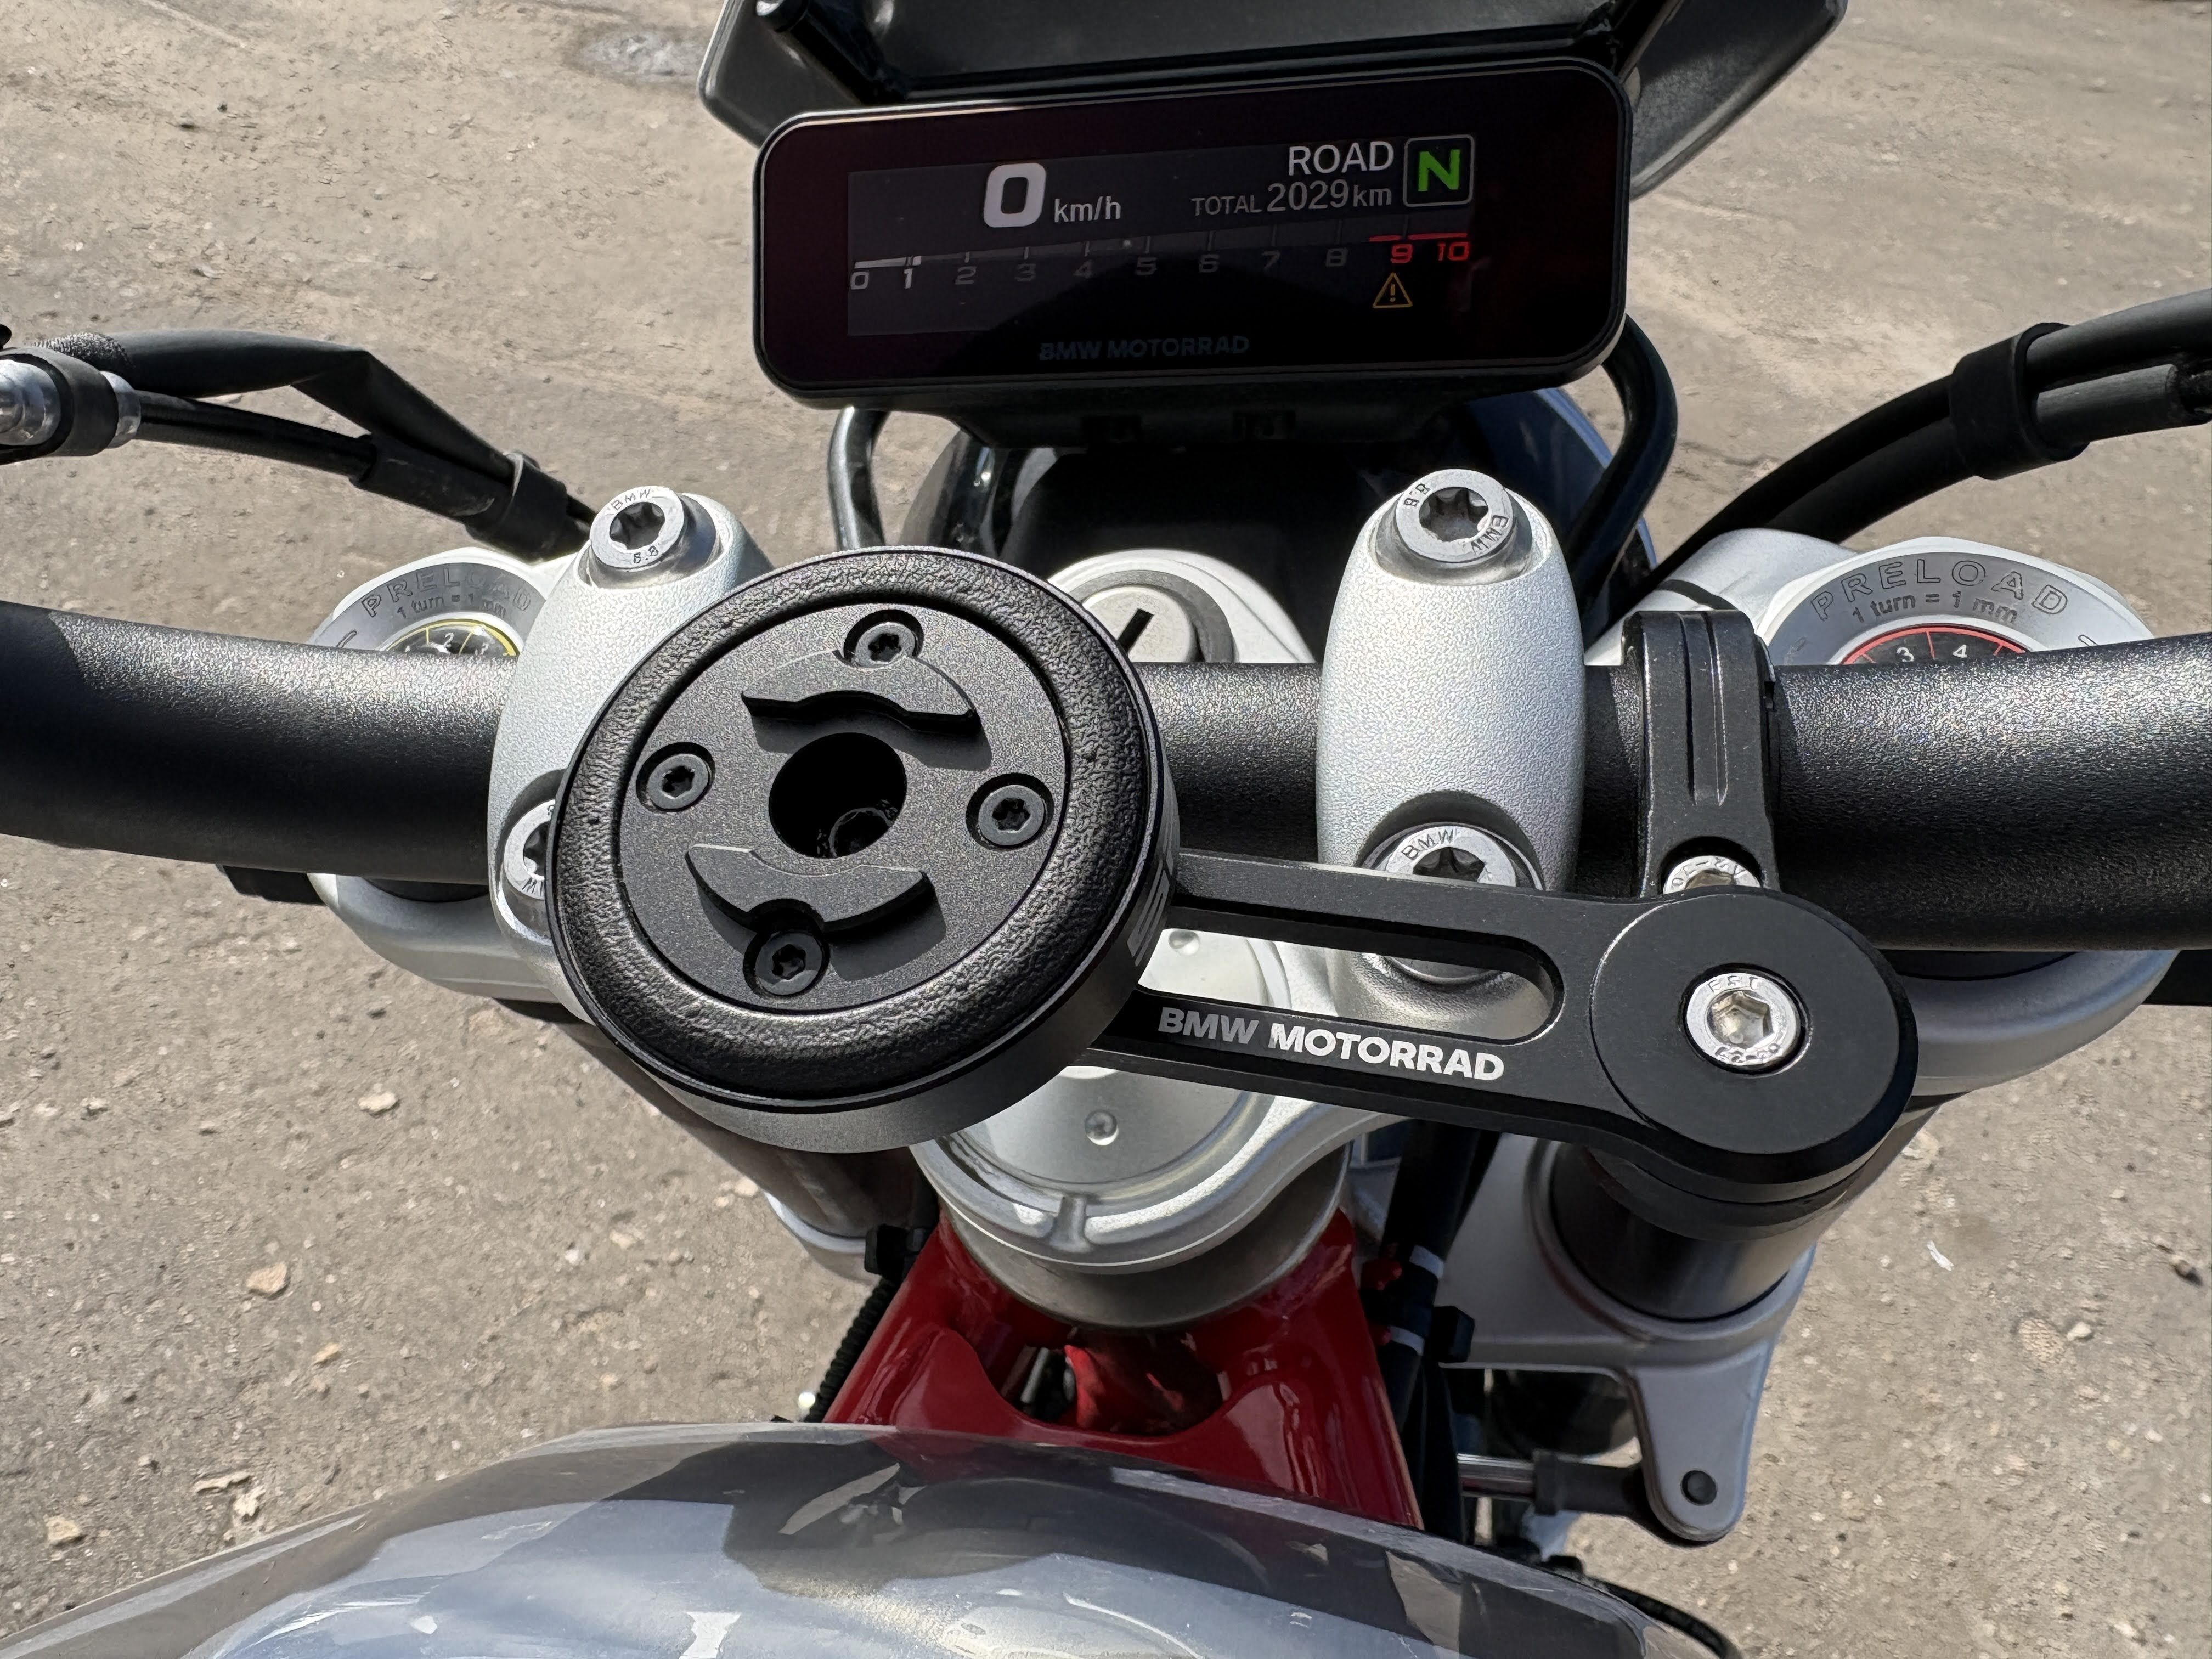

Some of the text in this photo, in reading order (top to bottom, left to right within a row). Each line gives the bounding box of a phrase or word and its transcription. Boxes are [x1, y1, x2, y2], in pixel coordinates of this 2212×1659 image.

[1288, 141, 1394, 176] ROAD
[1417, 149, 1460, 192] N
[984, 162, 1121, 228] 0 km/h
[1191, 195, 1262, 216] TOTAL
[850, 241, 1470, 290] 0 1 2 3 4 5 6 7 8 9 10
[1039, 335, 1250, 360] BMW MOTORRAD
[361, 567, 531, 618] PRELOAD
[411, 596, 444, 613] turn
[1811, 558, 2068, 621] PRELOAD
[1853, 607, 1864, 623] 1
[1870, 594, 1916, 617] turn
[1953, 591, 1961, 608] 1
[1972, 598, 2018, 623] mm
[1896, 644, 1968, 663] 3 4
[1401, 829, 1454, 861] BMW
[1158, 1006, 1504, 1081] BMW MOTORRAD
